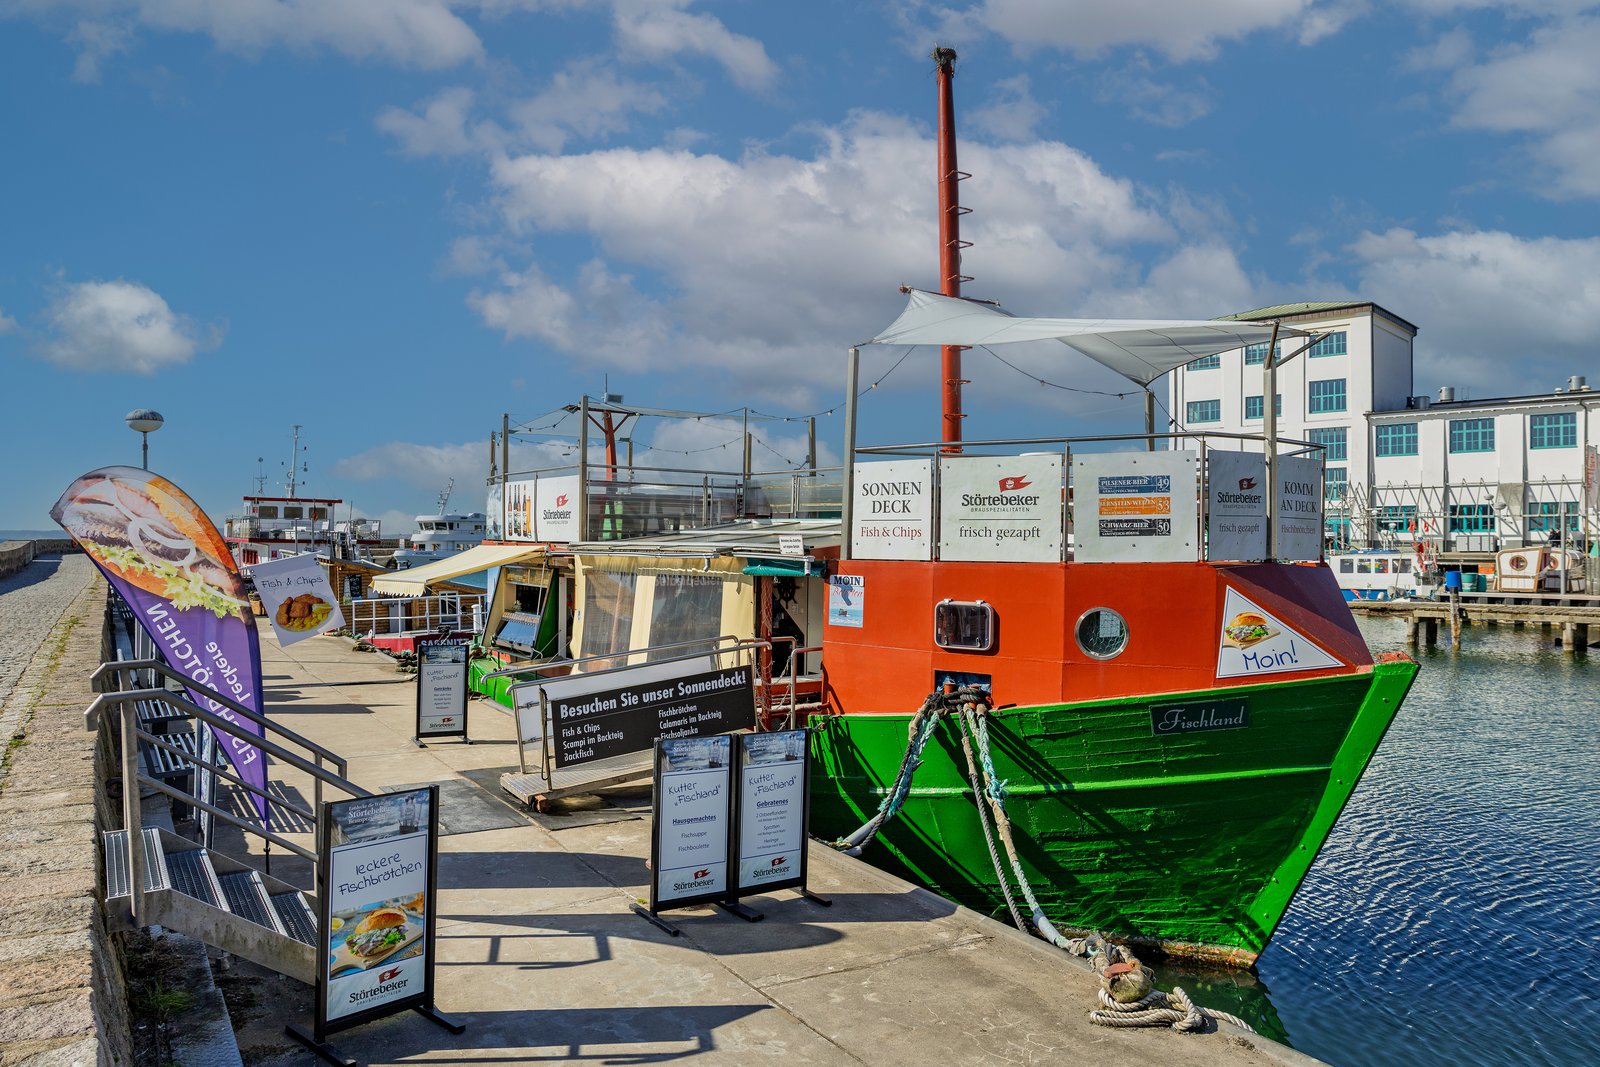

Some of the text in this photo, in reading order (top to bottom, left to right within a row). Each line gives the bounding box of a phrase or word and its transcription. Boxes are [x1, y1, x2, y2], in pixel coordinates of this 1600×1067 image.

[862, 482, 922, 497] SONNEN
[1157, 479, 1170, 489] 49
[1284, 481, 1313, 496] KOMM
[961, 493, 1040, 507] Störtebeker
[1217, 492, 1261, 504] Störtebeker
[872, 500, 911, 514] DECK
[1280, 500, 1317, 513] AN DECK
[861, 526, 922, 540] Fish & Chips
[959, 525, 1041, 541] frisch gezapft
[1158, 521, 1170, 532] 50
[1219, 523, 1260, 534] frisch gezapft
[262, 575, 324, 589] Fish & Chips
[834, 576, 860, 586] MOIN
[1242, 640, 1298, 670] Moin!
[560, 670, 747, 718] Besuchen Sie unser Sonnendeck!
[658, 703, 698, 718] Fischbrötchen
[659, 718, 688, 729] Calamaris
[698, 710, 722, 722] Backteig
[1158, 706, 1244, 731] Fischland
[562, 724, 601, 738] Fish & Chips
[660, 726, 698, 739] Fischsoljanka
[563, 731, 624, 750] Scampi im Backteig
[564, 748, 594, 762] Backfisch
[750, 772, 775, 785] Kutter
[668, 781, 697, 795] Kutter
[756, 799, 788, 808] Gebratenes
[672, 814, 716, 825] Hausgemachtes
[680, 831, 708, 839] Fischsuppe
[678, 843, 710, 852] Fischboulette
[356, 852, 402, 875] leckere
[338, 860, 422, 896] Fischbrötchen
[753, 866, 790, 878] Störtebeker
[673, 878, 715, 891] Störtebeker
[349, 979, 408, 1003] Störtebeker
